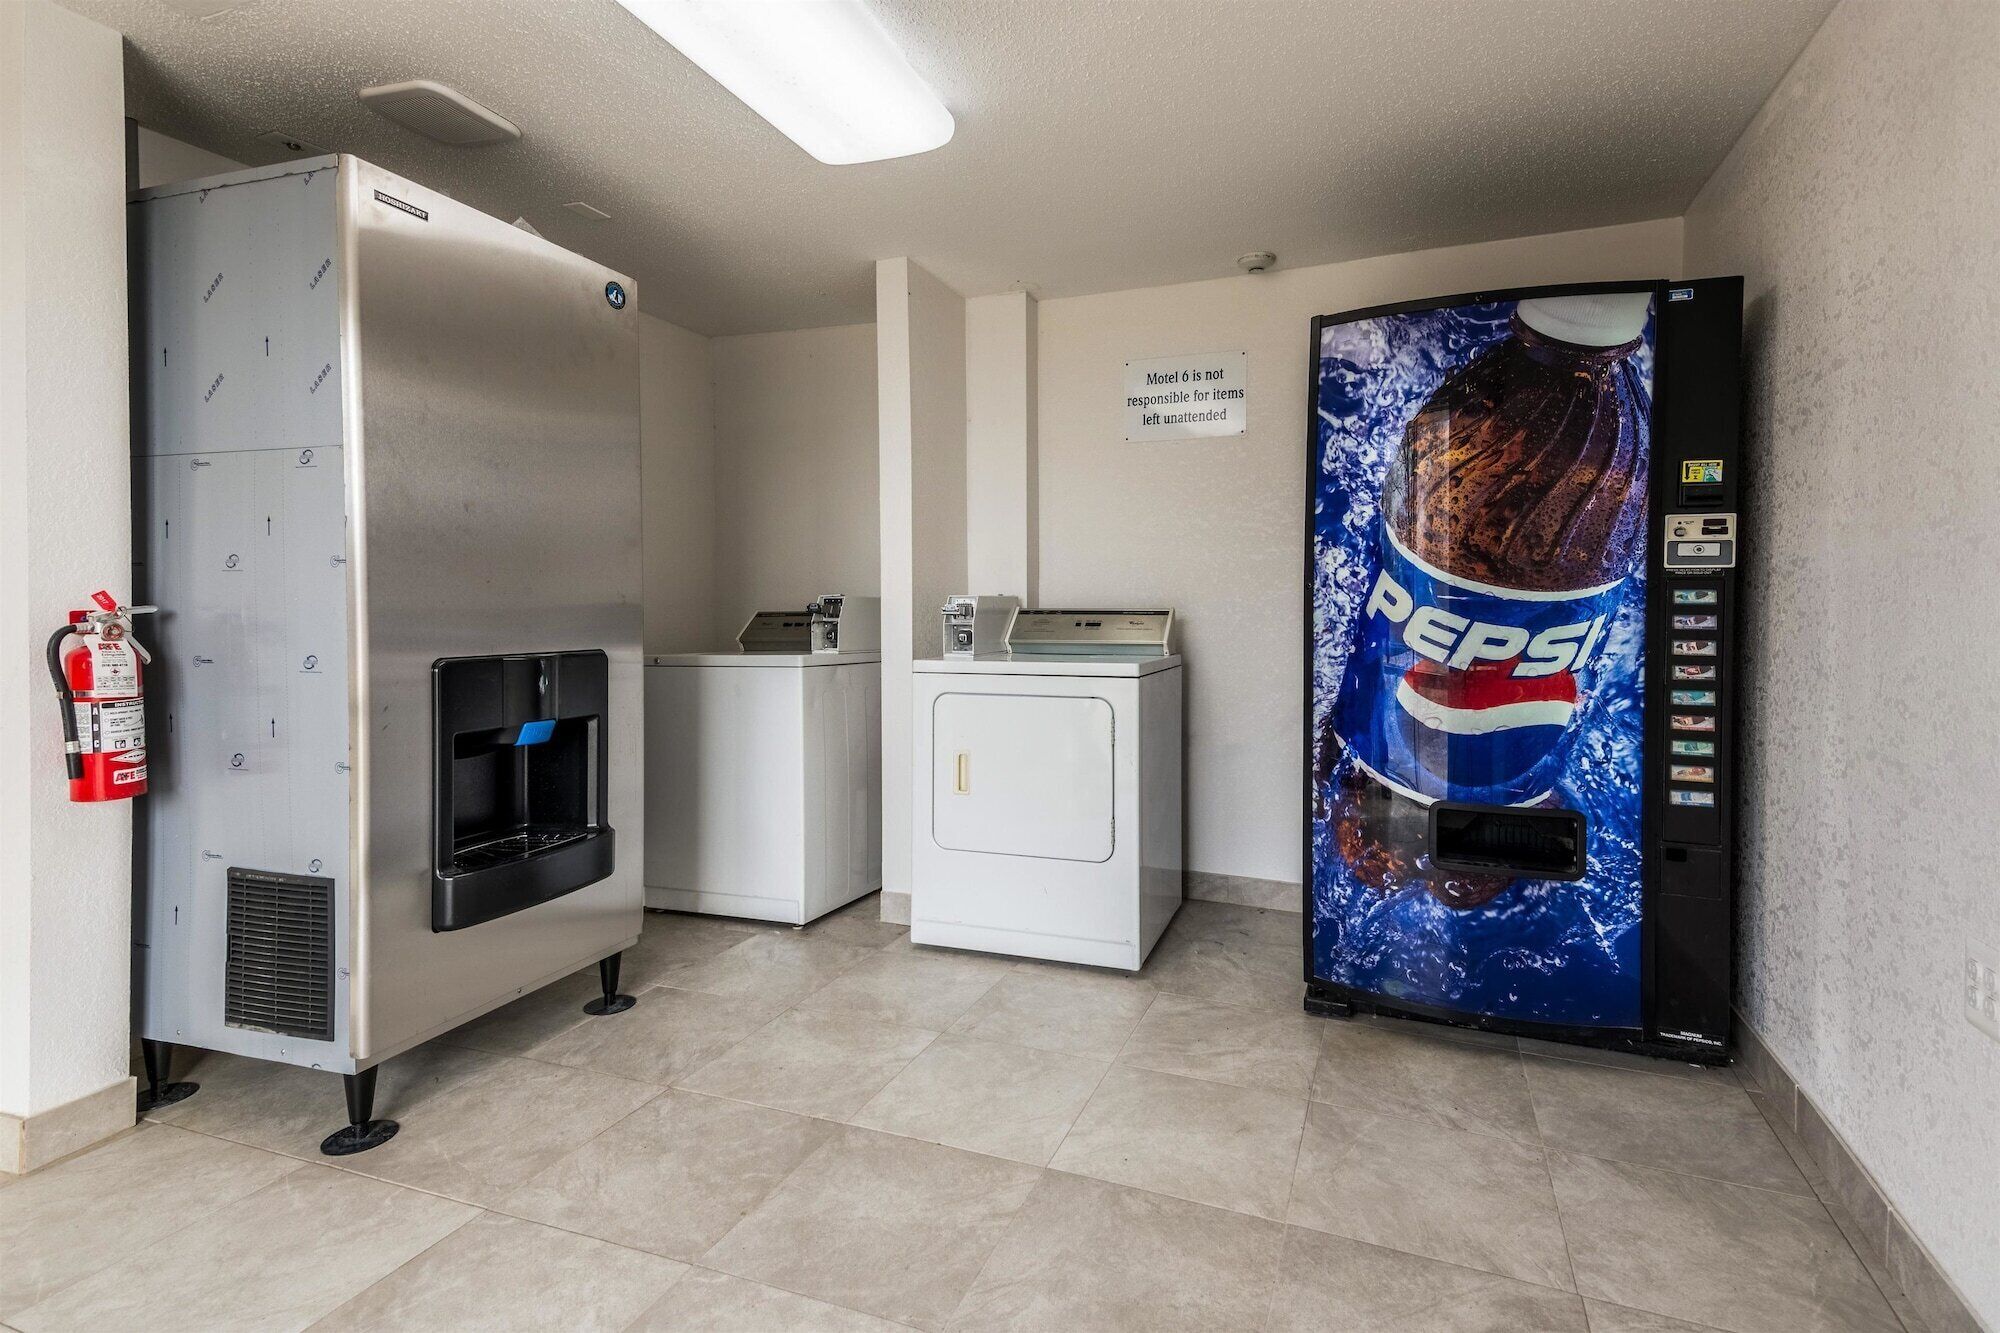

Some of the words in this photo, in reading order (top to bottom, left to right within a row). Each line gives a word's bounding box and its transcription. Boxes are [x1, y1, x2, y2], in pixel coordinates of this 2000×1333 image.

[378, 193, 427, 219] HOSHIZAKI
[309, 257, 332, 290] LASER
[203, 272, 224, 303] LASER
[204, 373, 225, 403] LASER
[309, 363, 332, 395] LASER
[1146, 371, 1178, 385] Motel
[1182, 370, 1189, 382] 6
[1192, 369, 1202, 381] is
[1205, 368, 1224, 380] not
[1127, 391, 1190, 408] responsible
[1193, 389, 1210, 402] for
[1213, 388, 1244, 400] items
[1142, 412, 1161, 426] left
[1164, 408, 1227, 424] unattended
[1366, 569, 1607, 677] PEPSI
[93, 707, 98, 715] A
[93, 723, 99, 732] B
[94, 739, 100, 748] C
